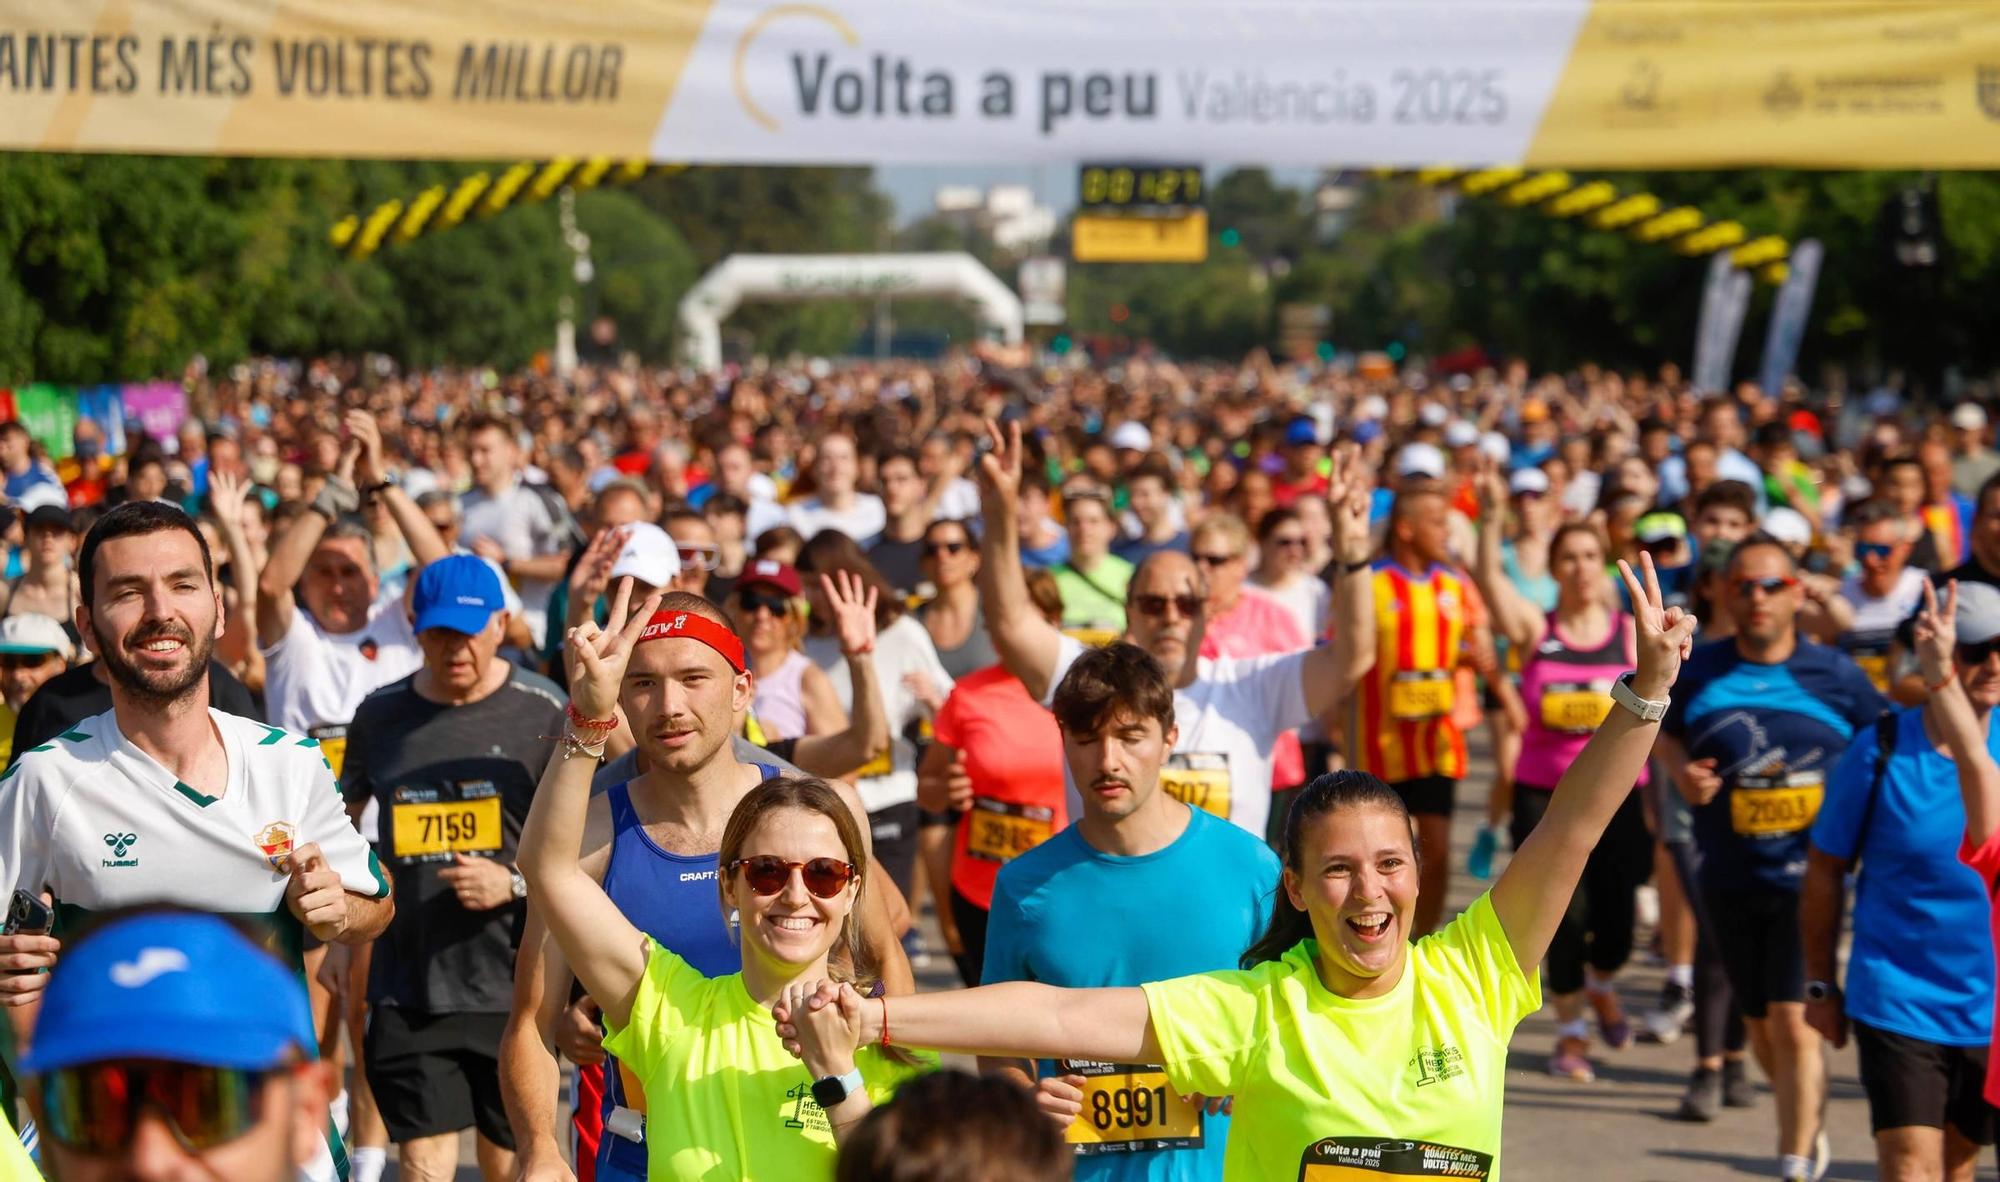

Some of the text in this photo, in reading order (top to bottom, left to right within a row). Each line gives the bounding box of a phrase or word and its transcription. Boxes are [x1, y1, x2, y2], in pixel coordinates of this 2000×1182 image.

[158, 25, 254, 97] MÉS
[272, 38, 432, 99] VOLTES
[453, 42, 626, 101] MILLOR
[791, 52, 1508, 136] Volta a peu València 2025
[417, 811, 477, 843] 7159
[102, 858, 138, 868] hummel
[680, 871, 714, 882] CRAFT
[1092, 1086, 1167, 1130] 8991
[1324, 1144, 1350, 1156] Volta
[1352, 1147, 1359, 1156] a
[1424, 1149, 1478, 1163] QUANTES MÉS
[1338, 1156, 1381, 1168] València 2025
[1422, 1158, 1480, 1173] VOLTES MILLOR
